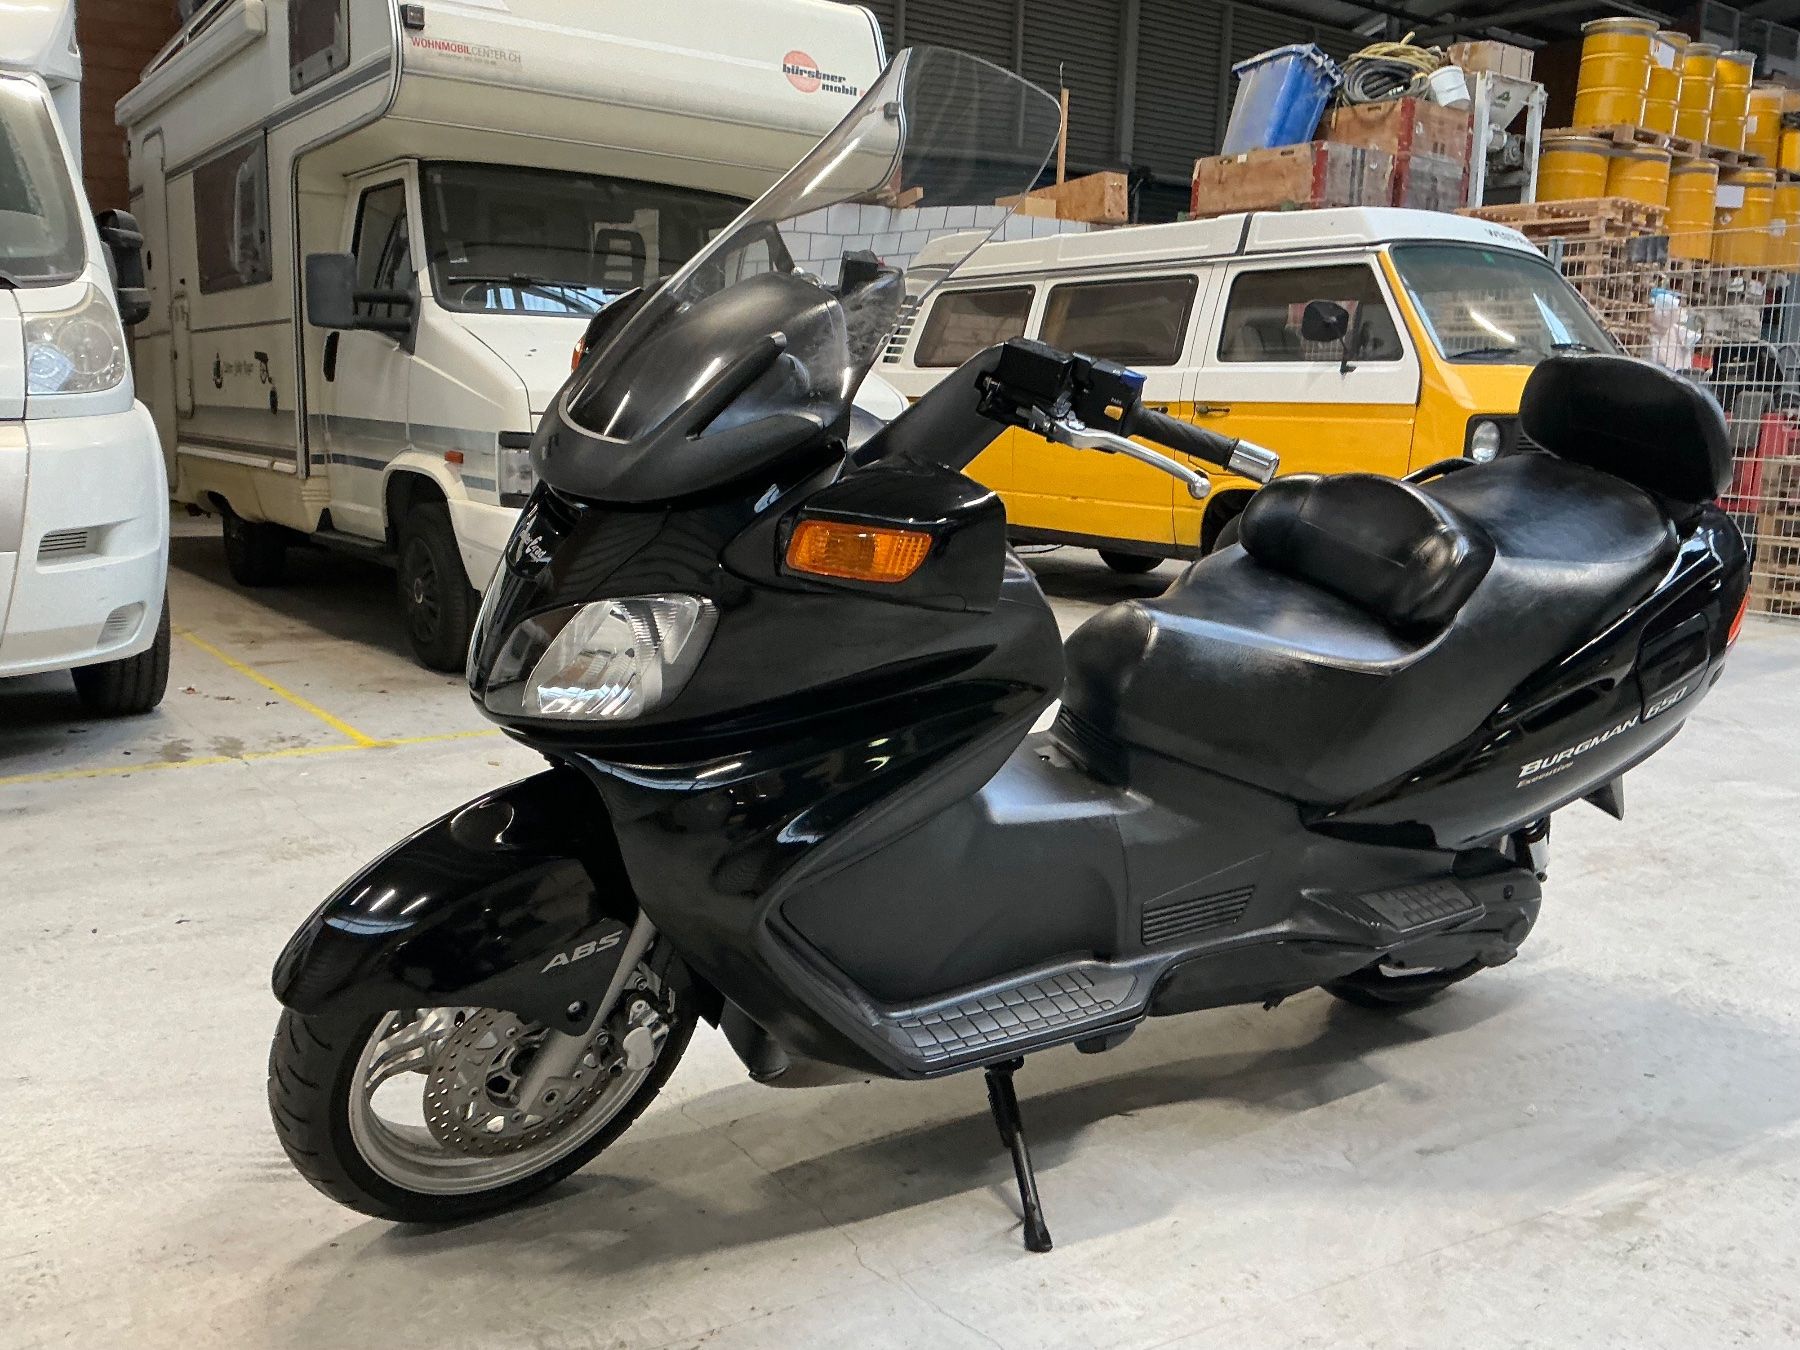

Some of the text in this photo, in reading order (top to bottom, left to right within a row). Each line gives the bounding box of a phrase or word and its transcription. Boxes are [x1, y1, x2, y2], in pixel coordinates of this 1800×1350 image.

[782, 63, 846, 83] bürstner
[821, 83, 857, 96] mobil
[1643, 685, 1688, 720] 650
[539, 929, 624, 974] ABS
